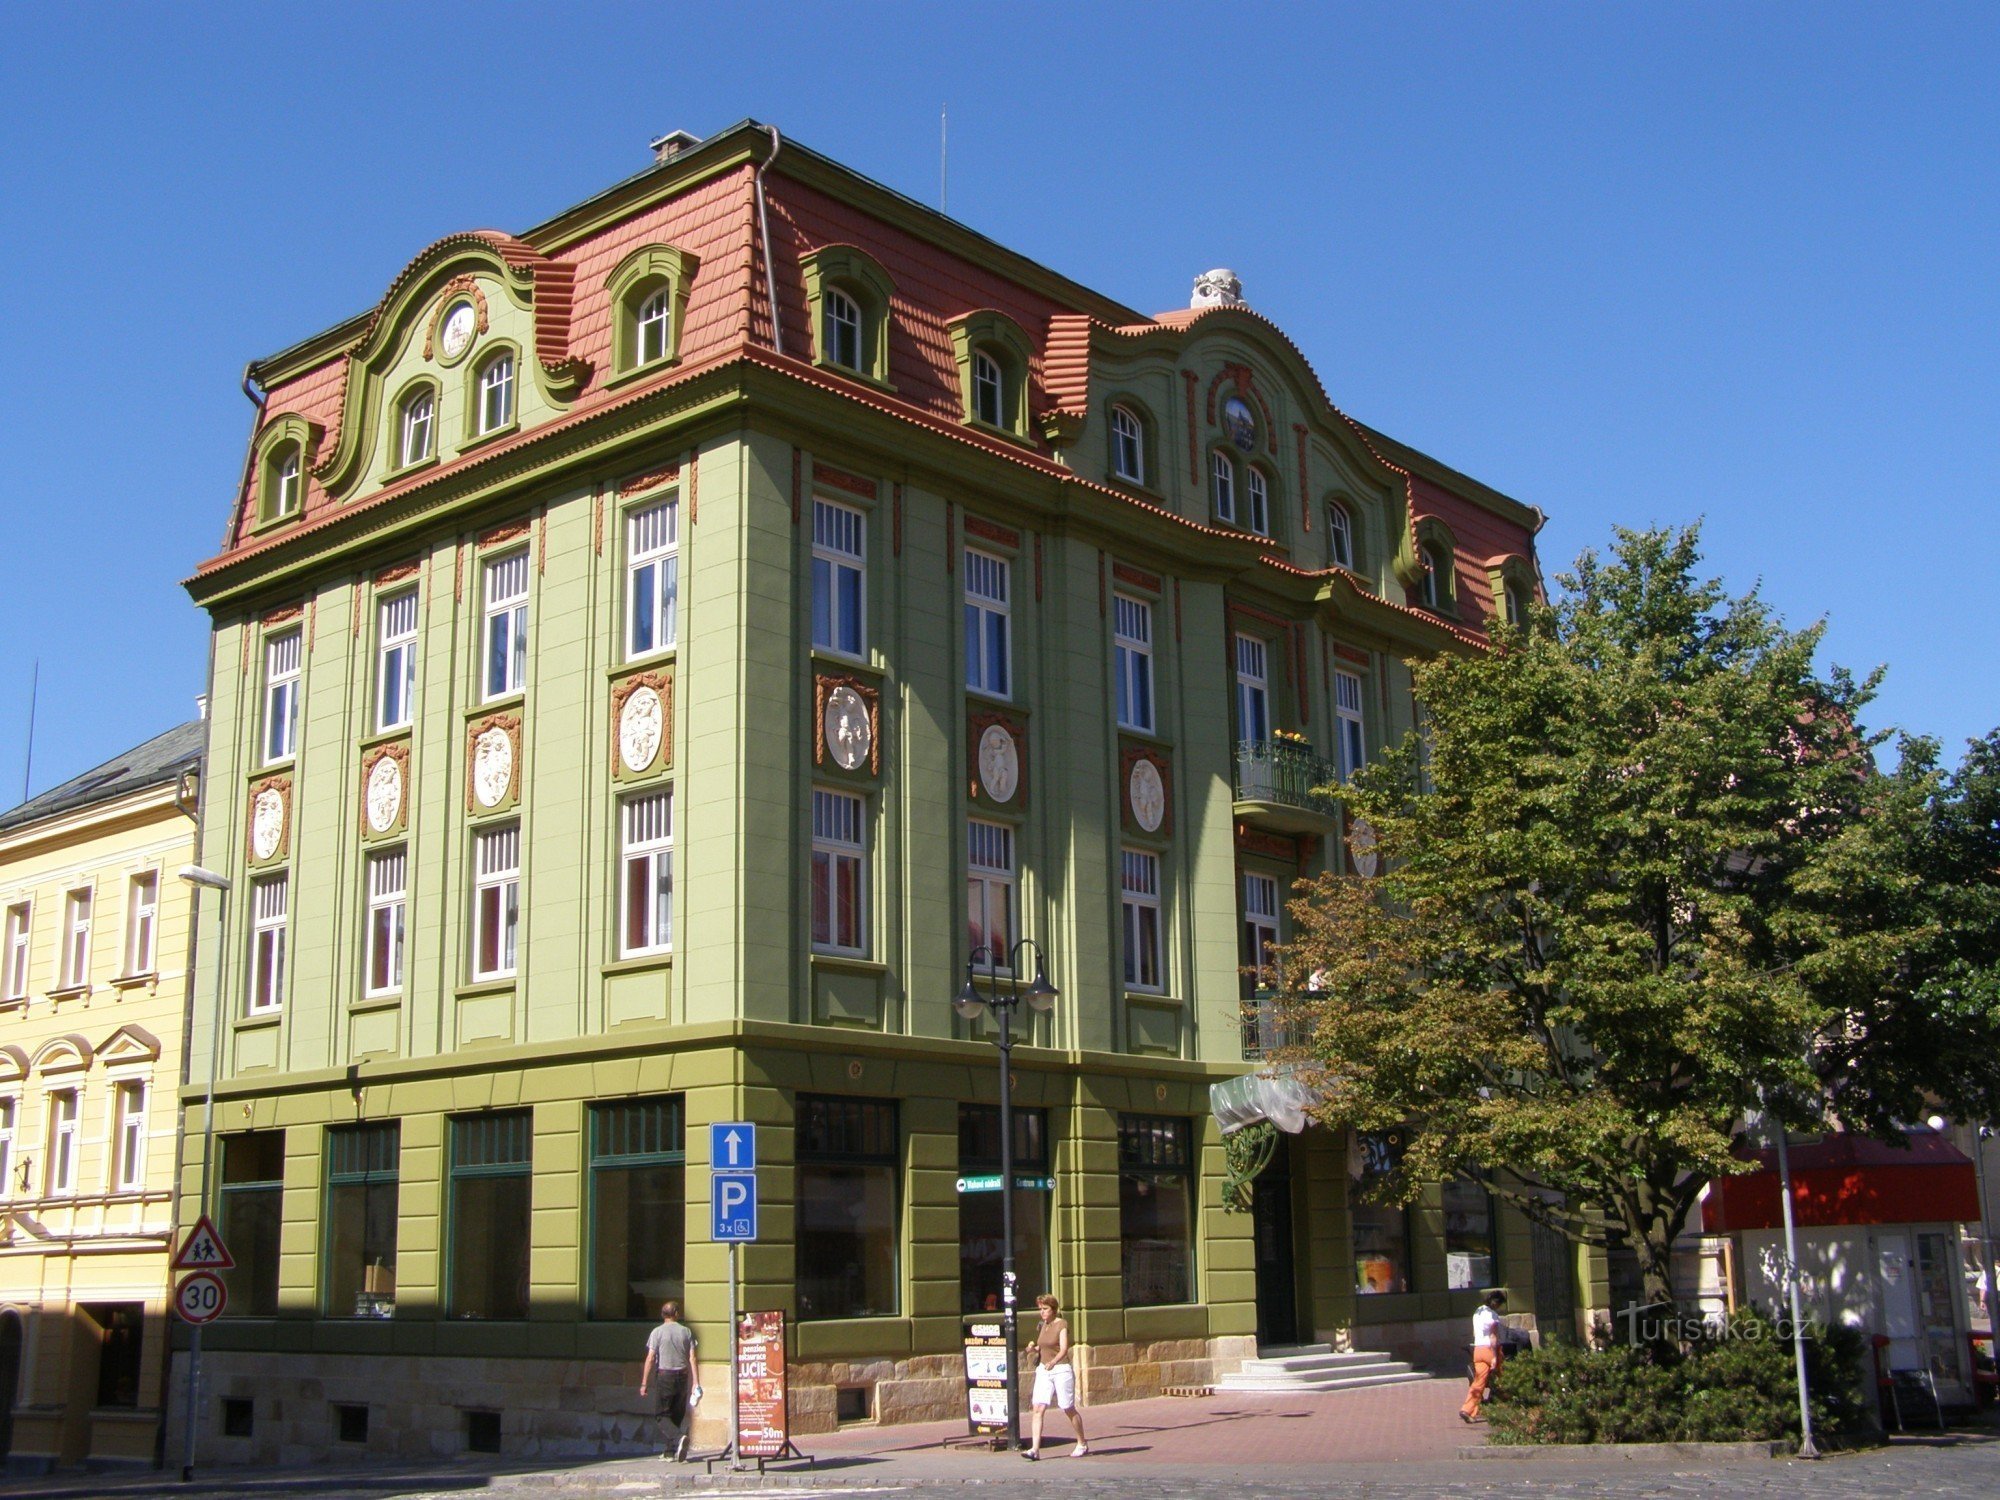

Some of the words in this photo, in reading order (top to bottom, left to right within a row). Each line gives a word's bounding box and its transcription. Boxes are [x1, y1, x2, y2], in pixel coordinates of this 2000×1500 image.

[721, 1182, 747, 1219] P
[185, 1285, 217, 1310] 30
[763, 1427, 784, 1439] 50m
